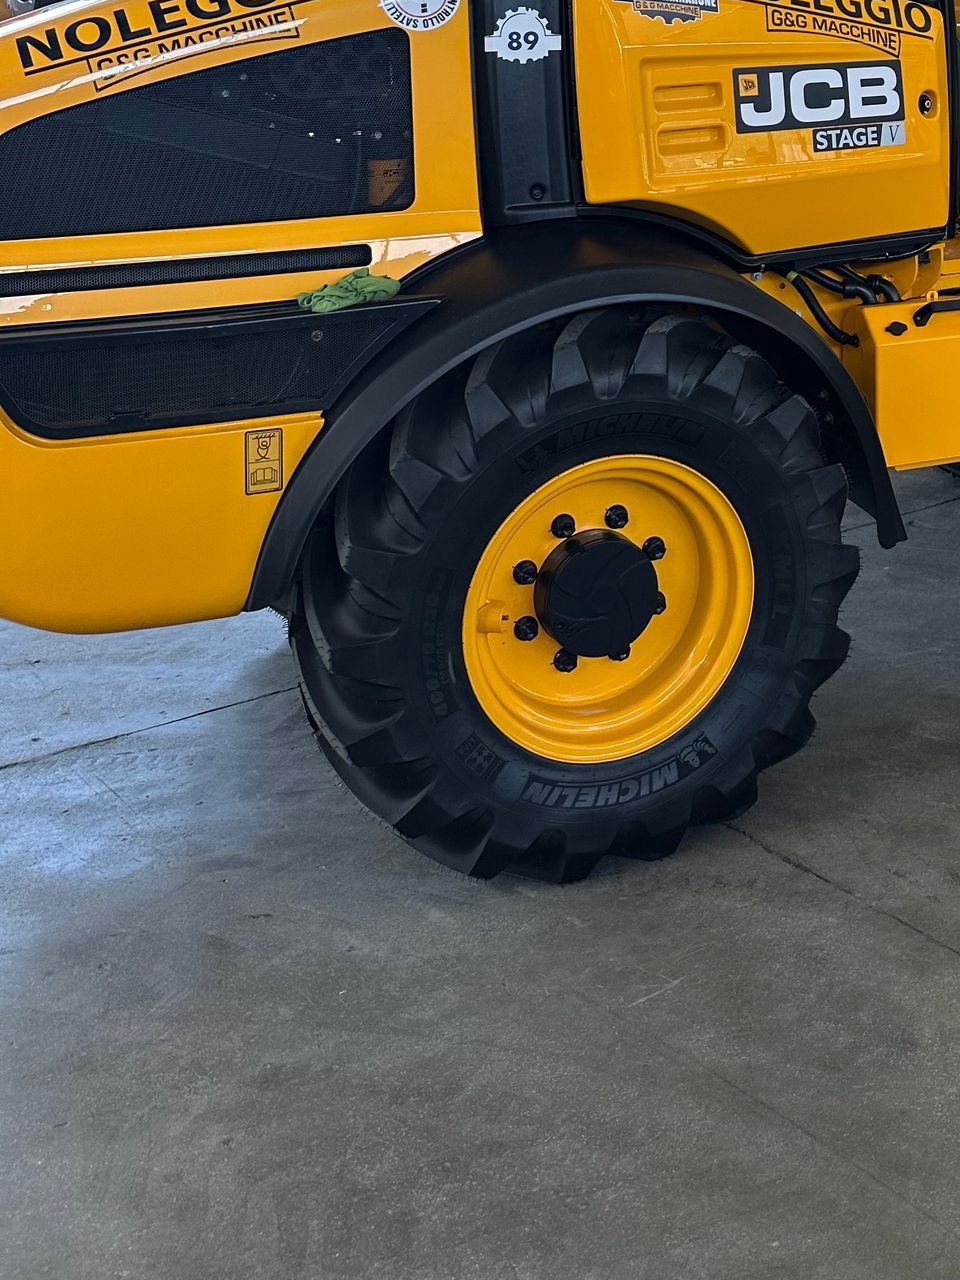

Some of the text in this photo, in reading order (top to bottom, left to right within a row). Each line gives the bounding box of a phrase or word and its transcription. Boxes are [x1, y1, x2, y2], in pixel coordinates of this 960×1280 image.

[656, 2, 699, 15] MACCHINE
[507, 31, 539, 51] 89
[771, 9, 897, 51] G&G MACCHINE
[740, 66, 900, 127] JCB
[816, 125, 900, 150] STAGE V
[519, 760, 679, 808] MICHELIN
